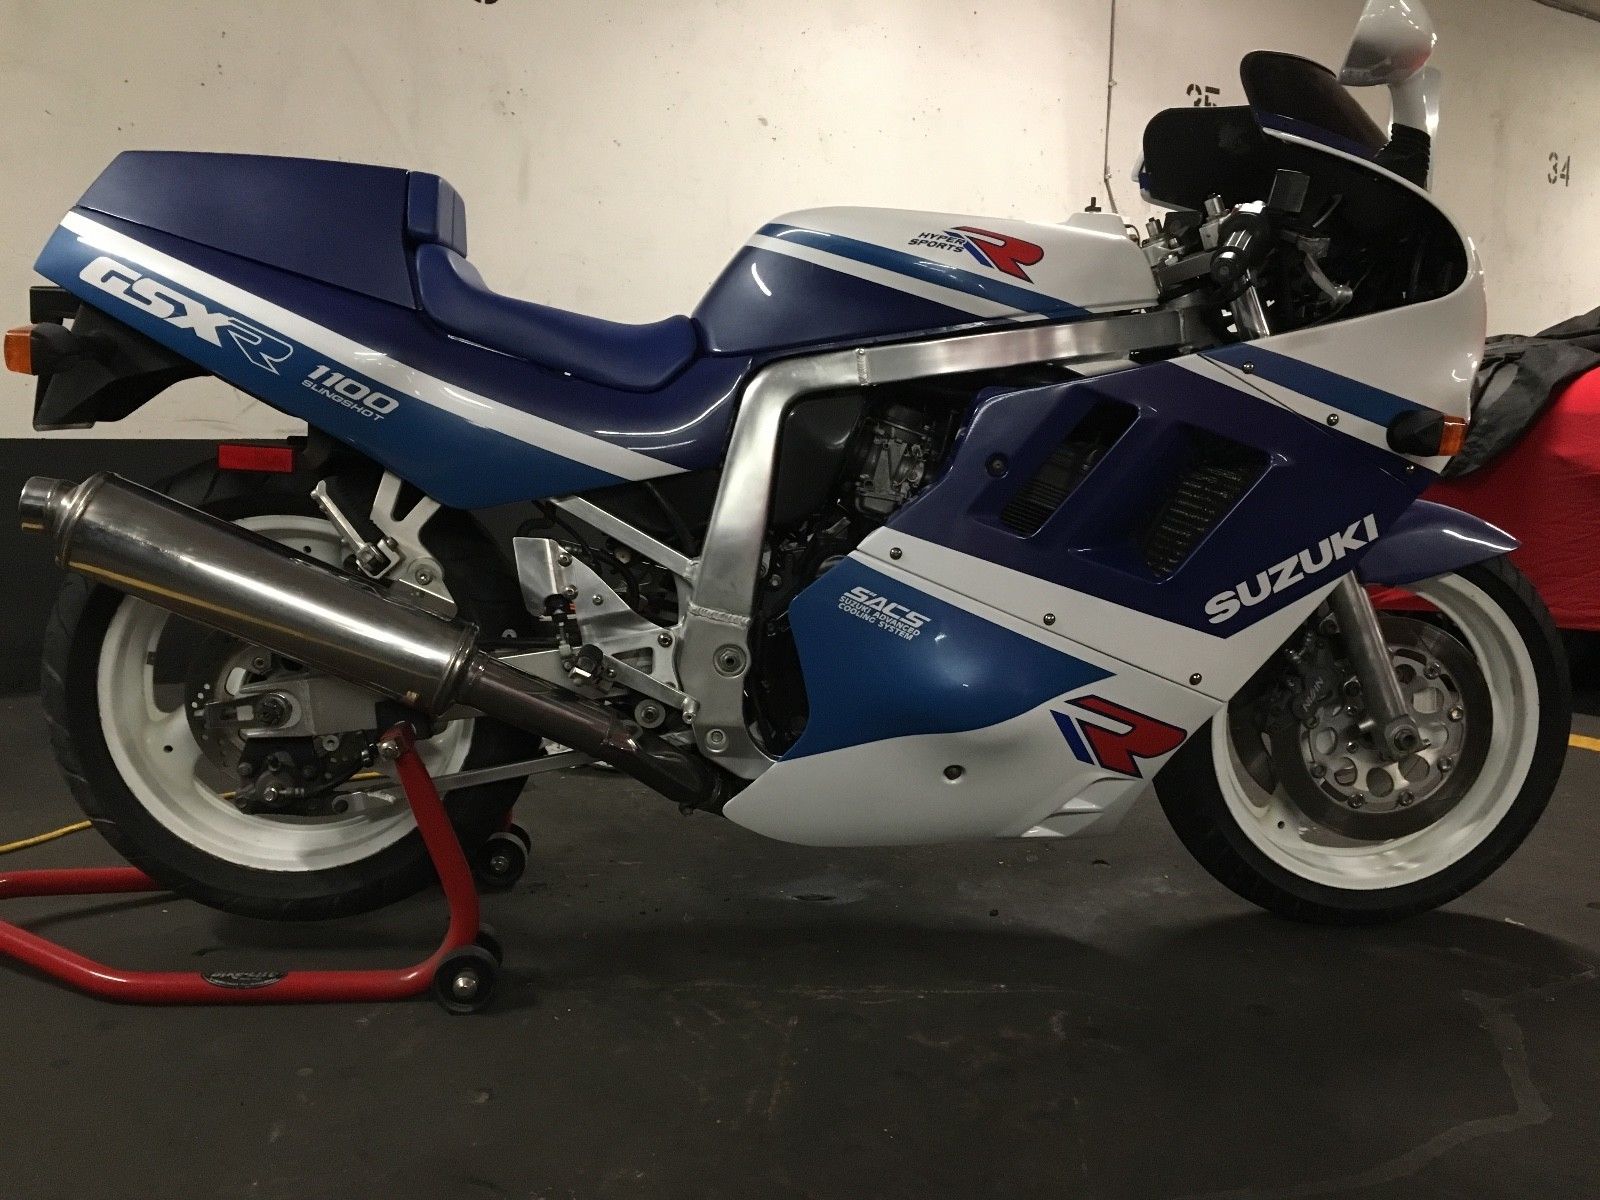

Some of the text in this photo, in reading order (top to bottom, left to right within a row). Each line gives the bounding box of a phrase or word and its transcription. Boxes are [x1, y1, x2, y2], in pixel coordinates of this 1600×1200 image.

[1548, 152, 1570, 187] 34
[908, 238, 964, 253] SPORTS
[918, 232, 967, 245] HYPER
[301, 379, 384, 422] SLINGSHOT
[304, 364, 399, 415] 1100
[1204, 513, 1379, 624] SUZUKI
[838, 603, 914, 641] COOLING SYSTEM
[839, 595, 920, 636] SUZUKI ADVANCED
[843, 586, 932, 628] SACS
